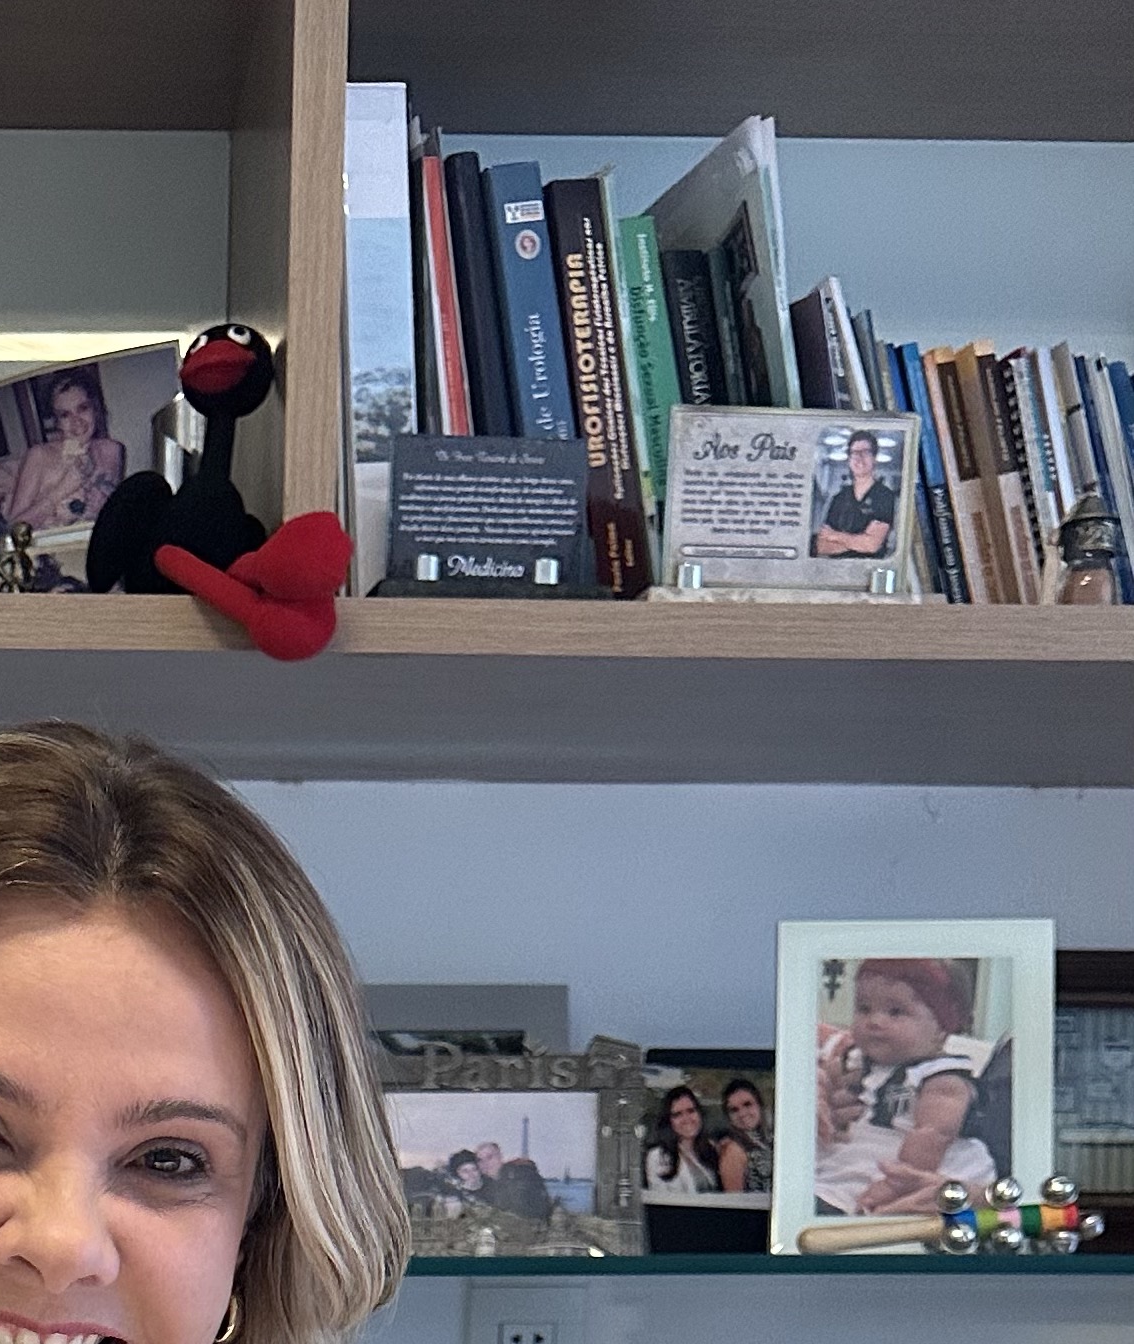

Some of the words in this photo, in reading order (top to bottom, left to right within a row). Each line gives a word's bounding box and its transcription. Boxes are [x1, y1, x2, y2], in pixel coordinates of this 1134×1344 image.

[523, 312, 551, 399] Urologia
[567, 253, 607, 468] UROFISIOTERAPIA
[535, 406, 555, 430] de
[746, 432, 799, 461] Pais
[447, 554, 526, 578] Medicina
[416, 1041, 580, 1090] Paris
